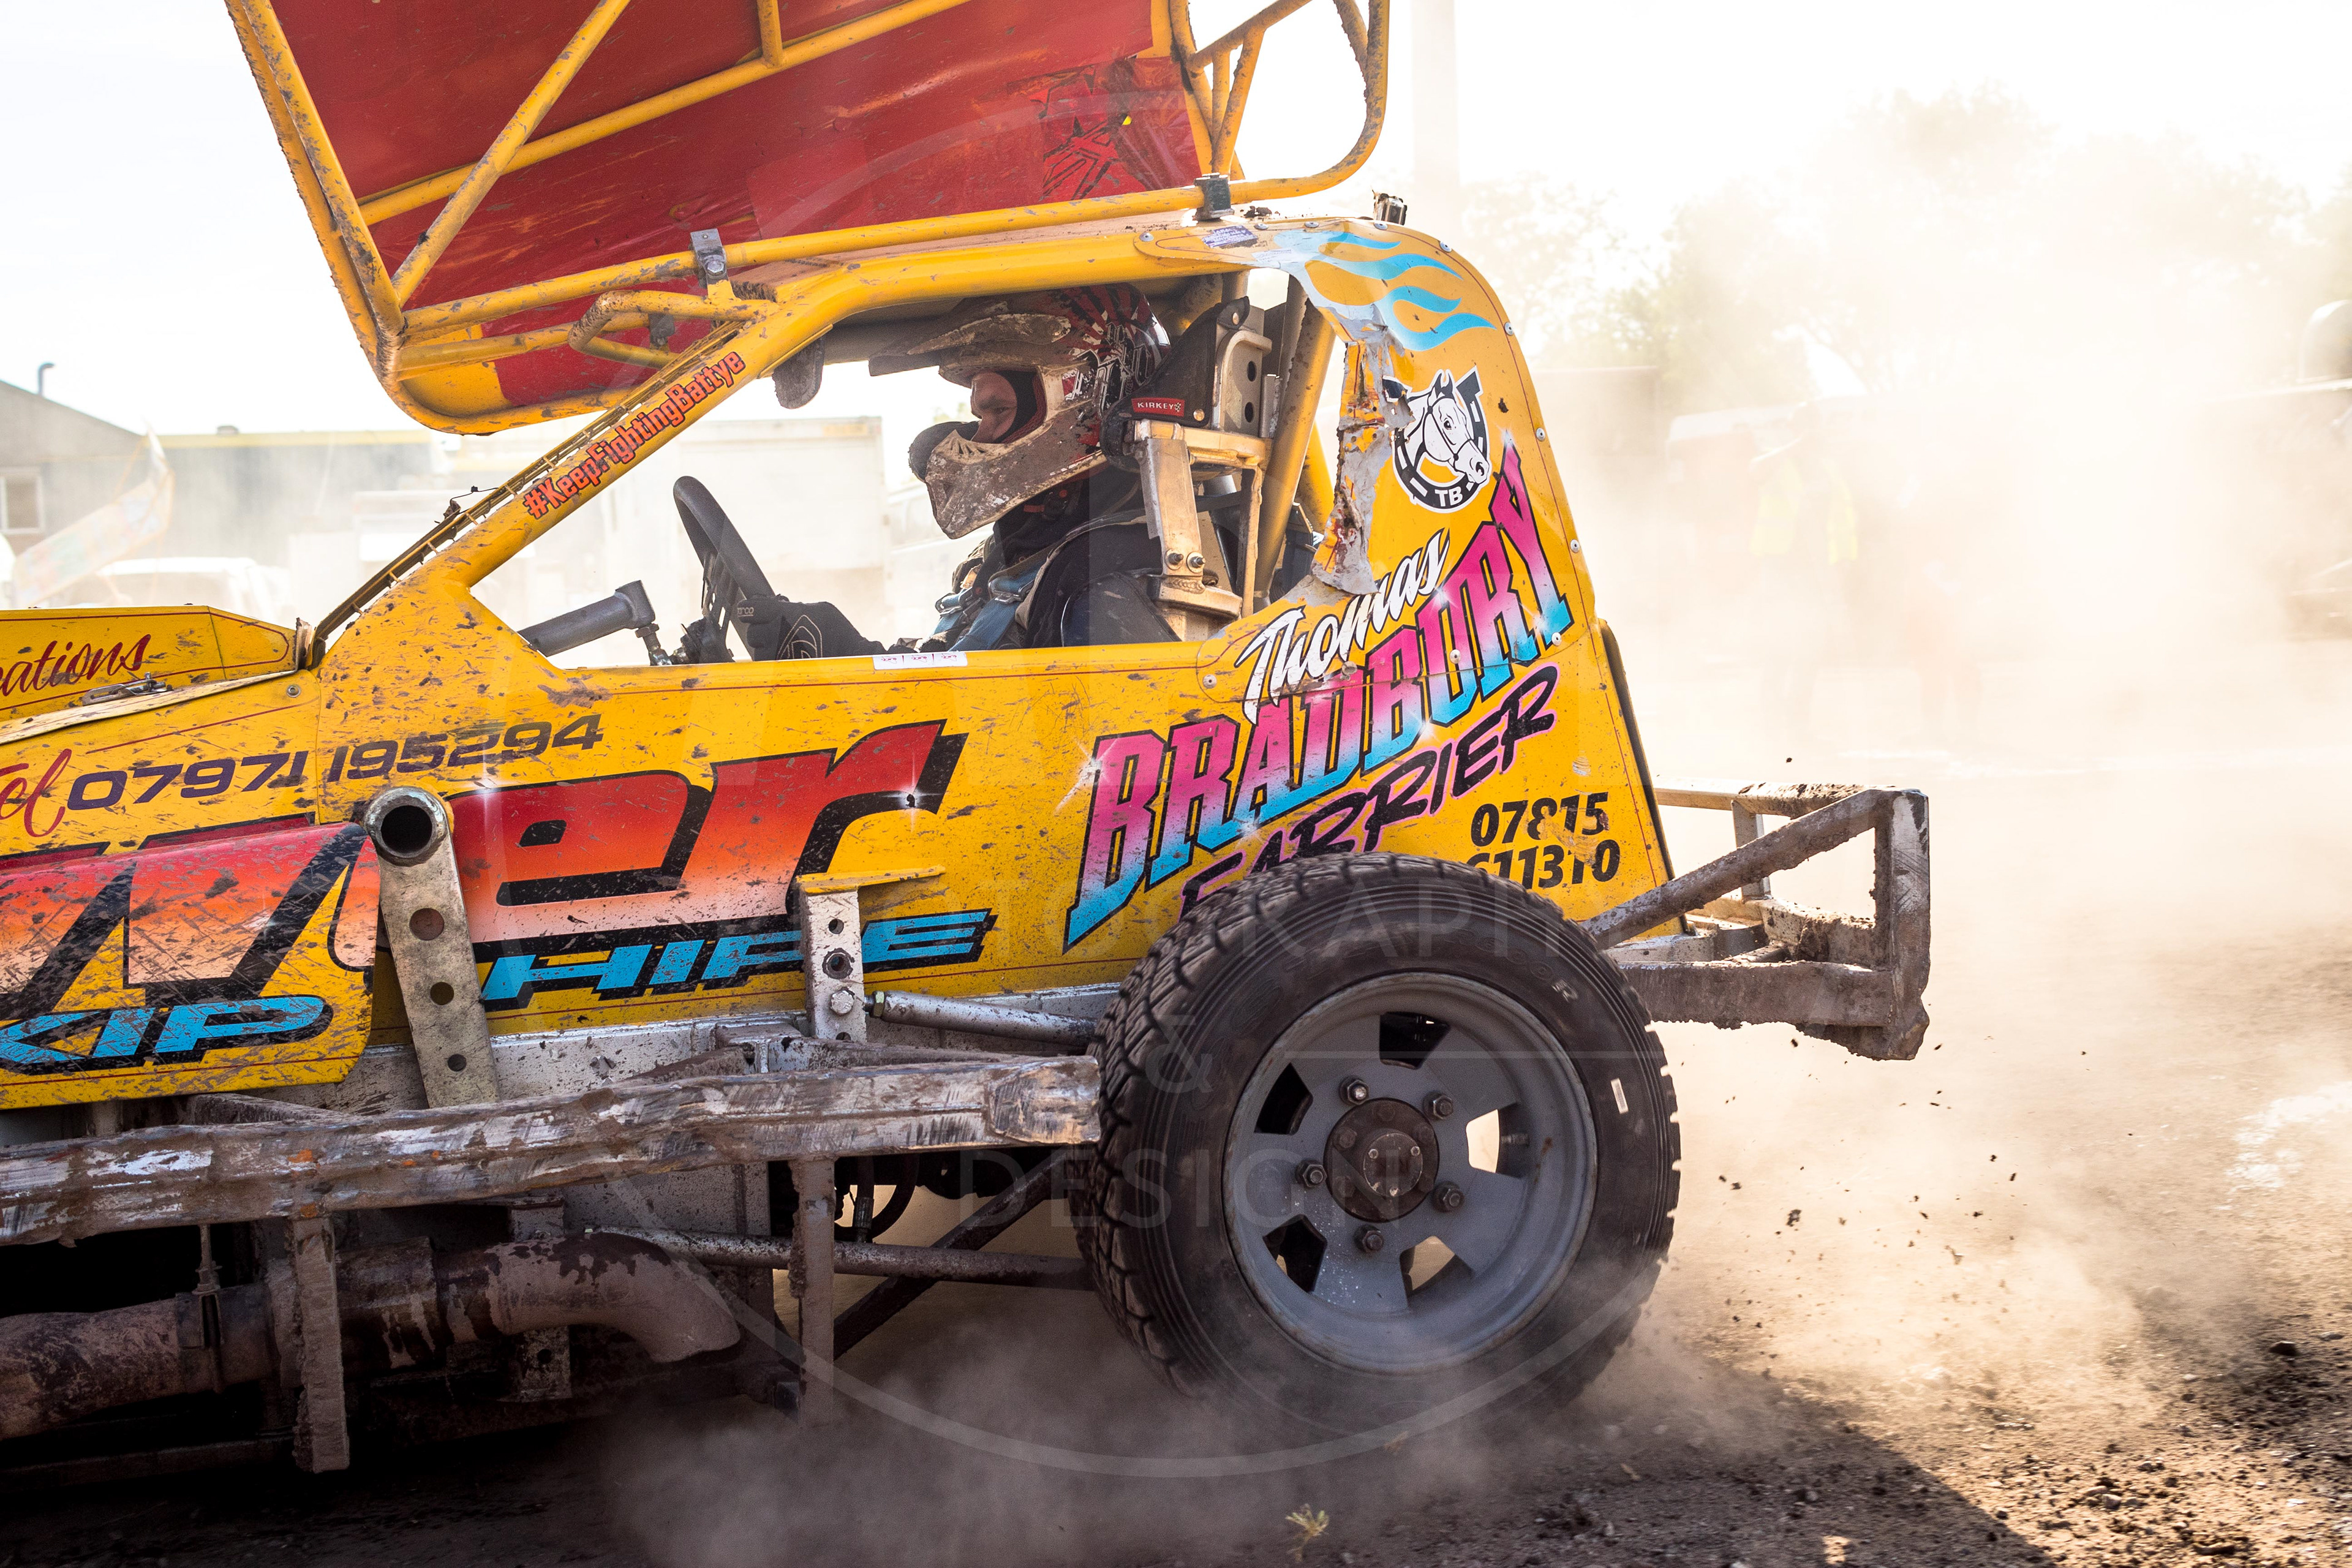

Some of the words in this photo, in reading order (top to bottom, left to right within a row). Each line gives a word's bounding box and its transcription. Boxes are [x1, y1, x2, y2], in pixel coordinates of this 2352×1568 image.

[523, 352, 745, 519] #KeepFightingBattye
[1434, 486, 1463, 507] TB
[0, 635, 151, 696] ations
[1234, 527, 1449, 726] Thomas
[1063, 431, 1574, 954] BRADBURY
[67, 750, 309, 811] 07971
[327, 714, 604, 783] 195294
[1471, 791, 1609, 847] 07815
